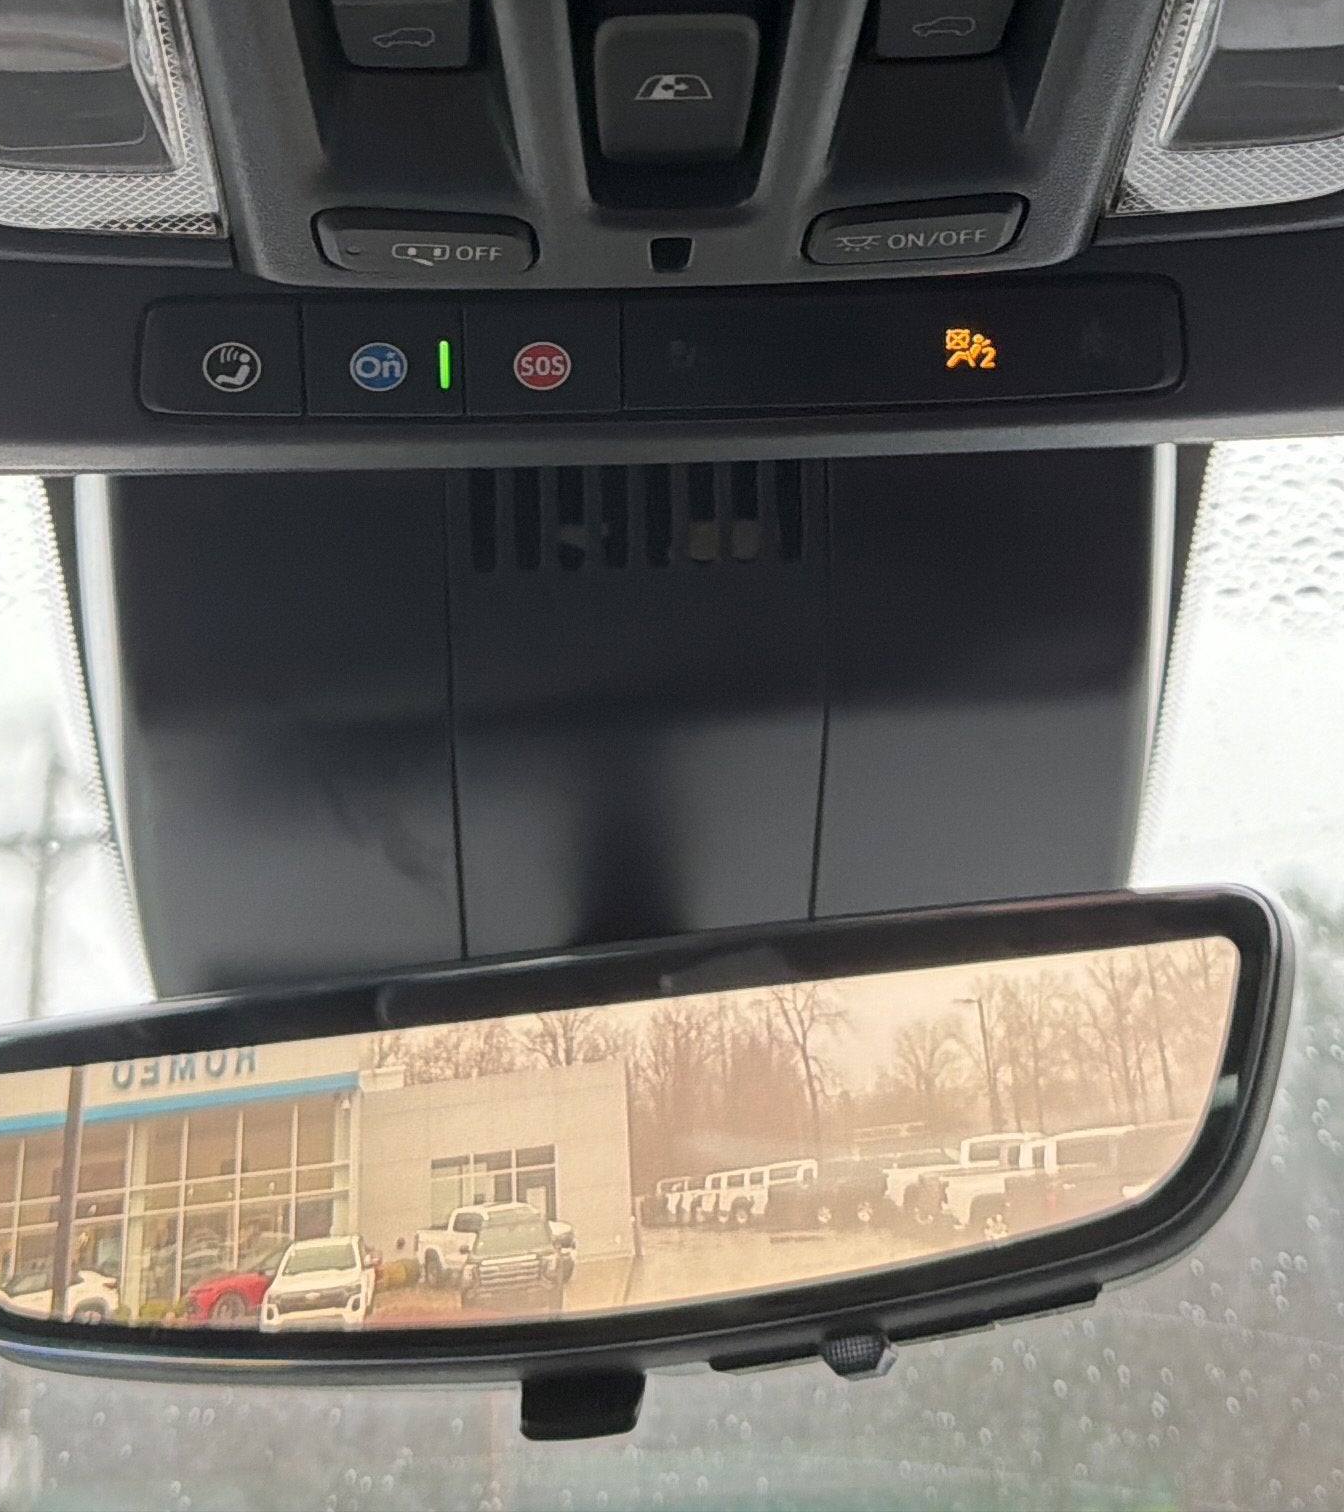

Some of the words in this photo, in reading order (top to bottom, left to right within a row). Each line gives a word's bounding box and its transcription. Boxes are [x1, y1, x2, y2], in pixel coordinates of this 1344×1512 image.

[887, 228, 987, 250] ON/OFF
[455, 244, 503, 262] OFF
[355, 354, 403, 379] On
[519, 354, 565, 377] SOS
